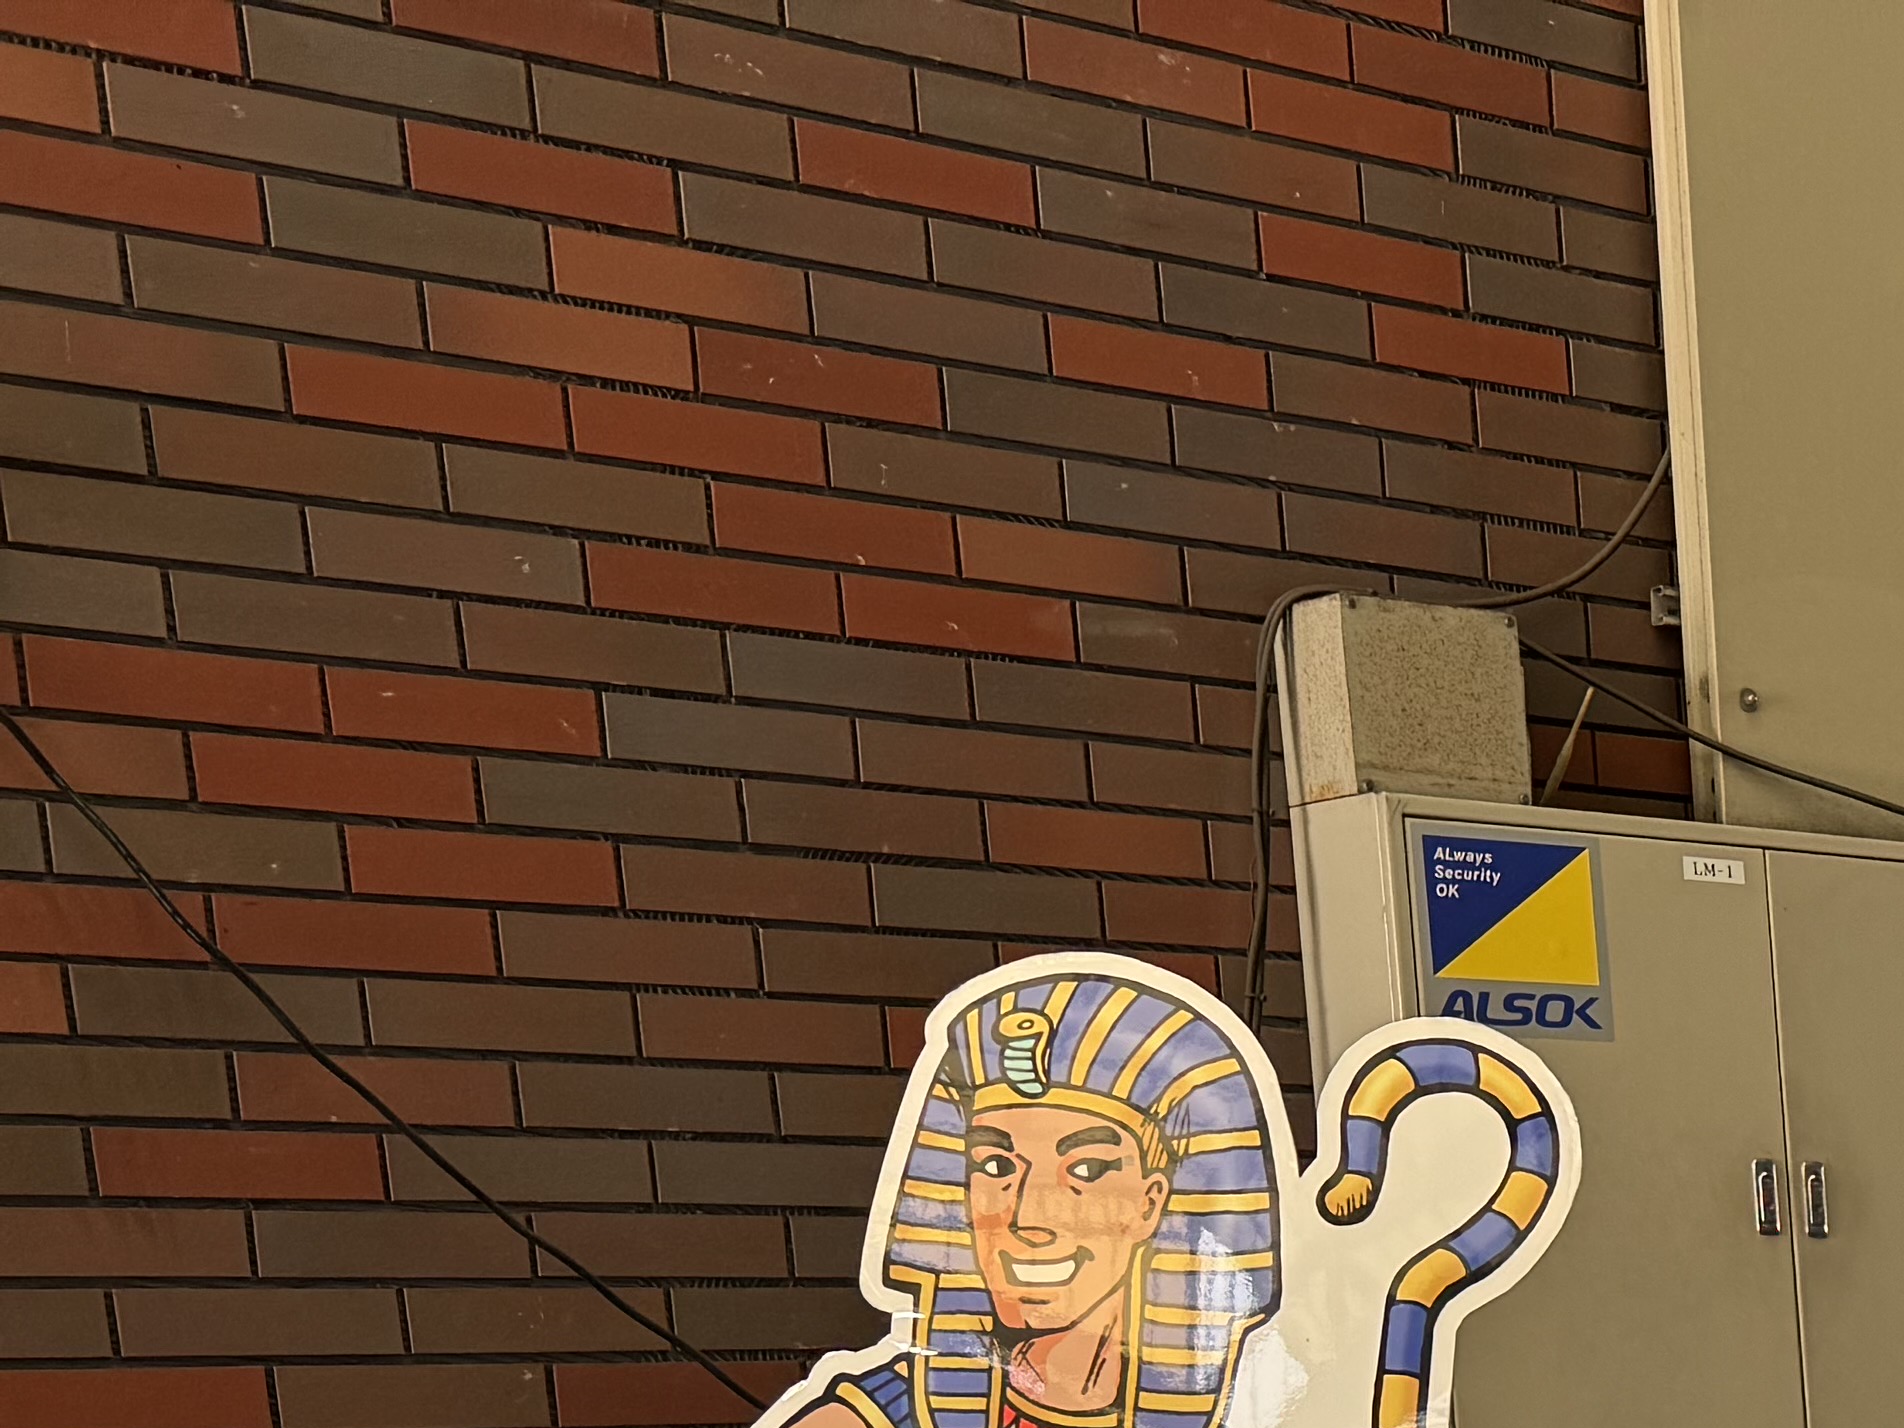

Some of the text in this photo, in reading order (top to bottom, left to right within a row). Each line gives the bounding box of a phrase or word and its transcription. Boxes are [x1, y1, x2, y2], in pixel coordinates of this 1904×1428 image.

[1433, 846, 1493, 865] ALways
[1434, 865, 1501, 887] Security
[1692, 861, 1733, 879] LM-1
[1435, 884, 1461, 899] OK
[1439, 988, 1603, 1030] ALSOK
